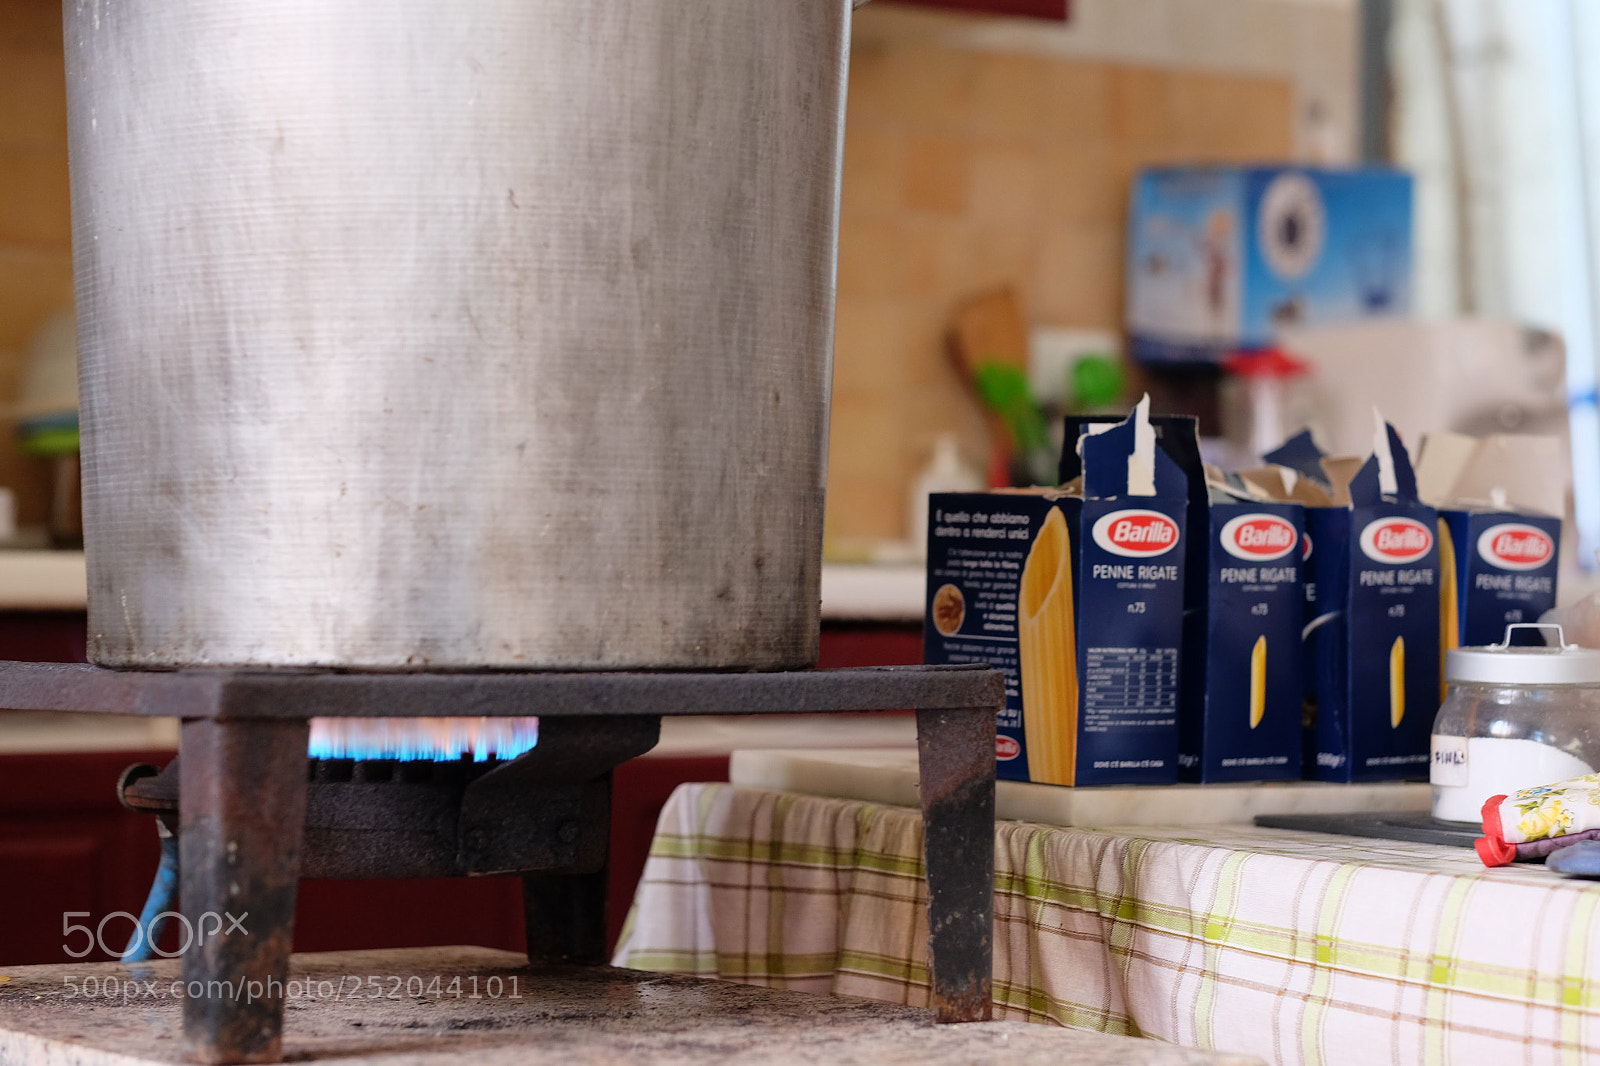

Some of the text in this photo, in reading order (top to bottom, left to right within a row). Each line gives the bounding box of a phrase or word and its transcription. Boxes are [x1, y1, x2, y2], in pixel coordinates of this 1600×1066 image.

[944, 511, 970, 523] quello
[972, 512, 988, 523] che
[990, 512, 1030, 524] abbiamo
[935, 526, 962, 538] dentro
[972, 528, 1006, 539] renderci
[1008, 528, 1029, 540] unici
[1113, 521, 1173, 543] Barilla
[1239, 524, 1290, 547] Barilla
[1378, 528, 1426, 550] Barilla
[1496, 534, 1548, 557] Barilla
[1093, 565, 1178, 580] PENNE RIGATE
[1220, 568, 1296, 583] PENNE RIGATE
[1360, 569, 1434, 586] PENNE RIGATE
[1476, 574, 1552, 593] PENNE RIGATE
